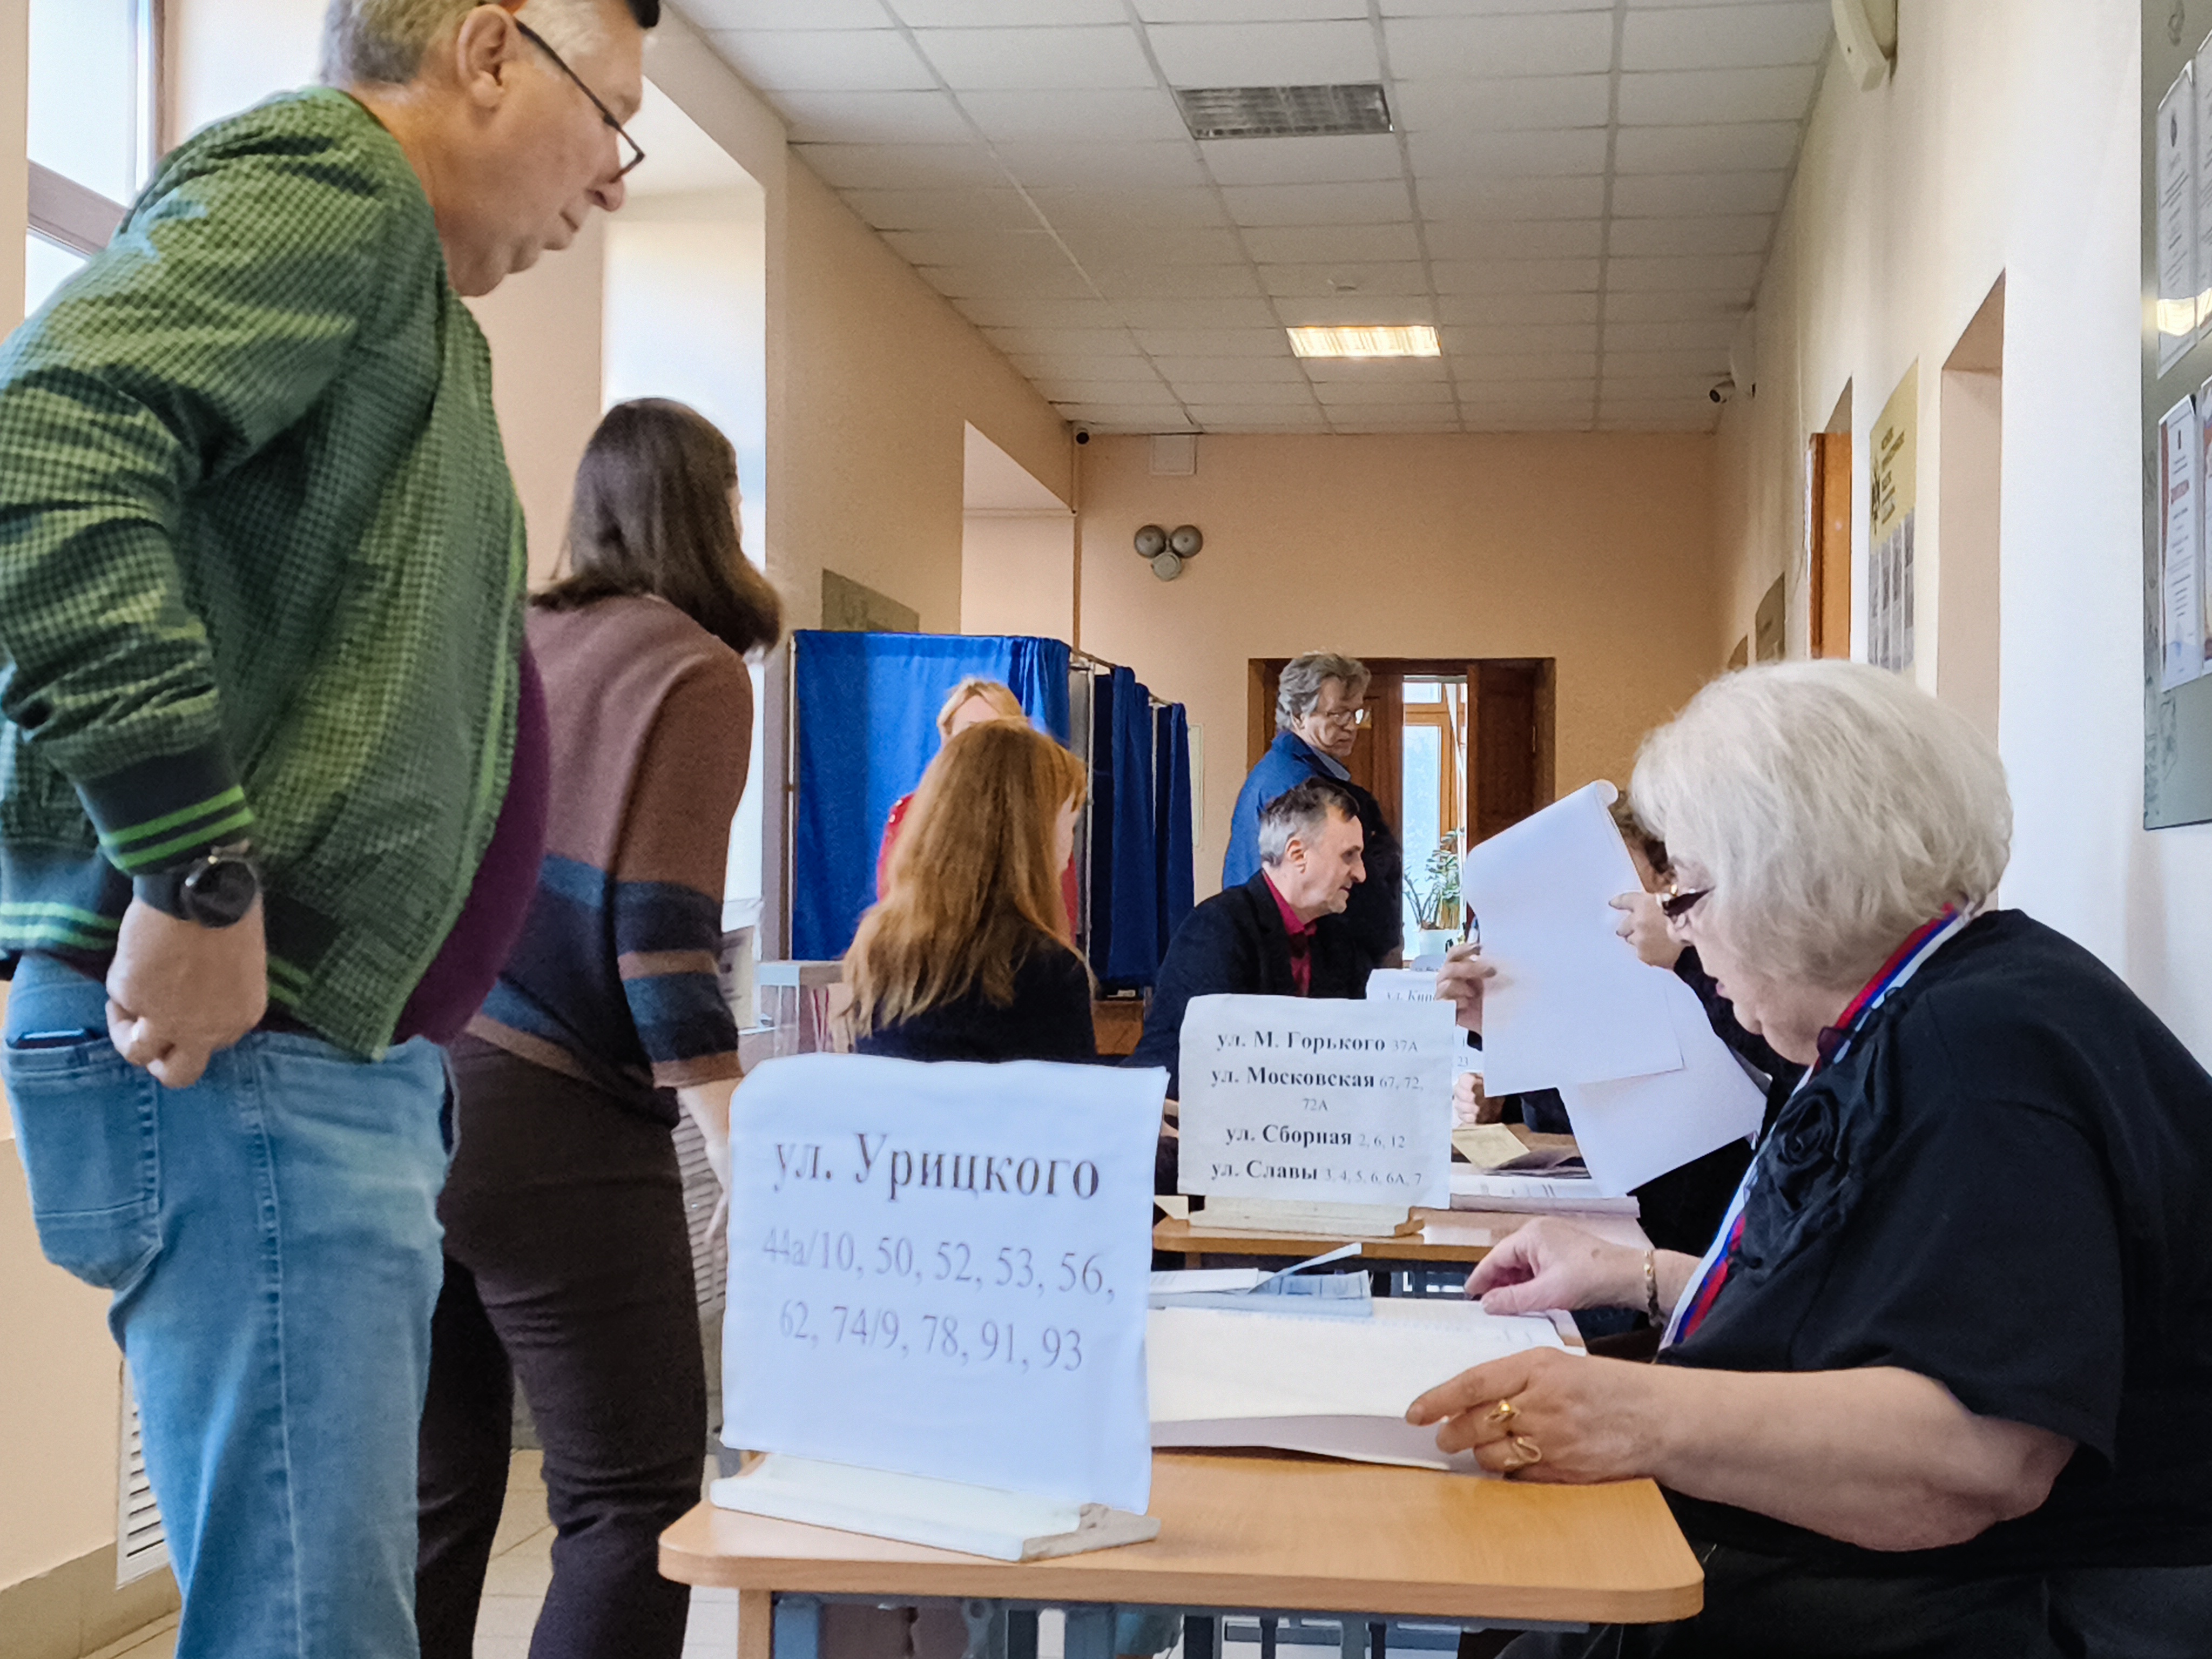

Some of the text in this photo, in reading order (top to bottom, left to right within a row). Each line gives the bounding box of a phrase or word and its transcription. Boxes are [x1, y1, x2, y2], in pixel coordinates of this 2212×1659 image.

[1217, 1033, 1245, 1051] ул.
[1253, 1030, 1279, 1048] М.
[1287, 1031, 1386, 1054] Горького
[1211, 1067, 1424, 1091] ул. Московская 67, 72,
[1302, 1098, 1328, 1111] 72А
[1225, 1127, 1256, 1146] ул.
[1262, 1124, 1352, 1148] Сборная
[1374, 1135, 1386, 1149] 6,
[1391, 1135, 1406, 1149] 12
[773, 1132, 1100, 1201] ул. Урицкого
[1211, 1162, 1239, 1181] ул.
[1246, 1159, 1318, 1182] Славы
[1414, 1172, 1422, 1185] 7
[763, 1227, 1115, 1304] 44а/10, 50, 52, 53, 56,
[779, 1299, 1083, 1375] 62, 74/9, 78, 91, 93
